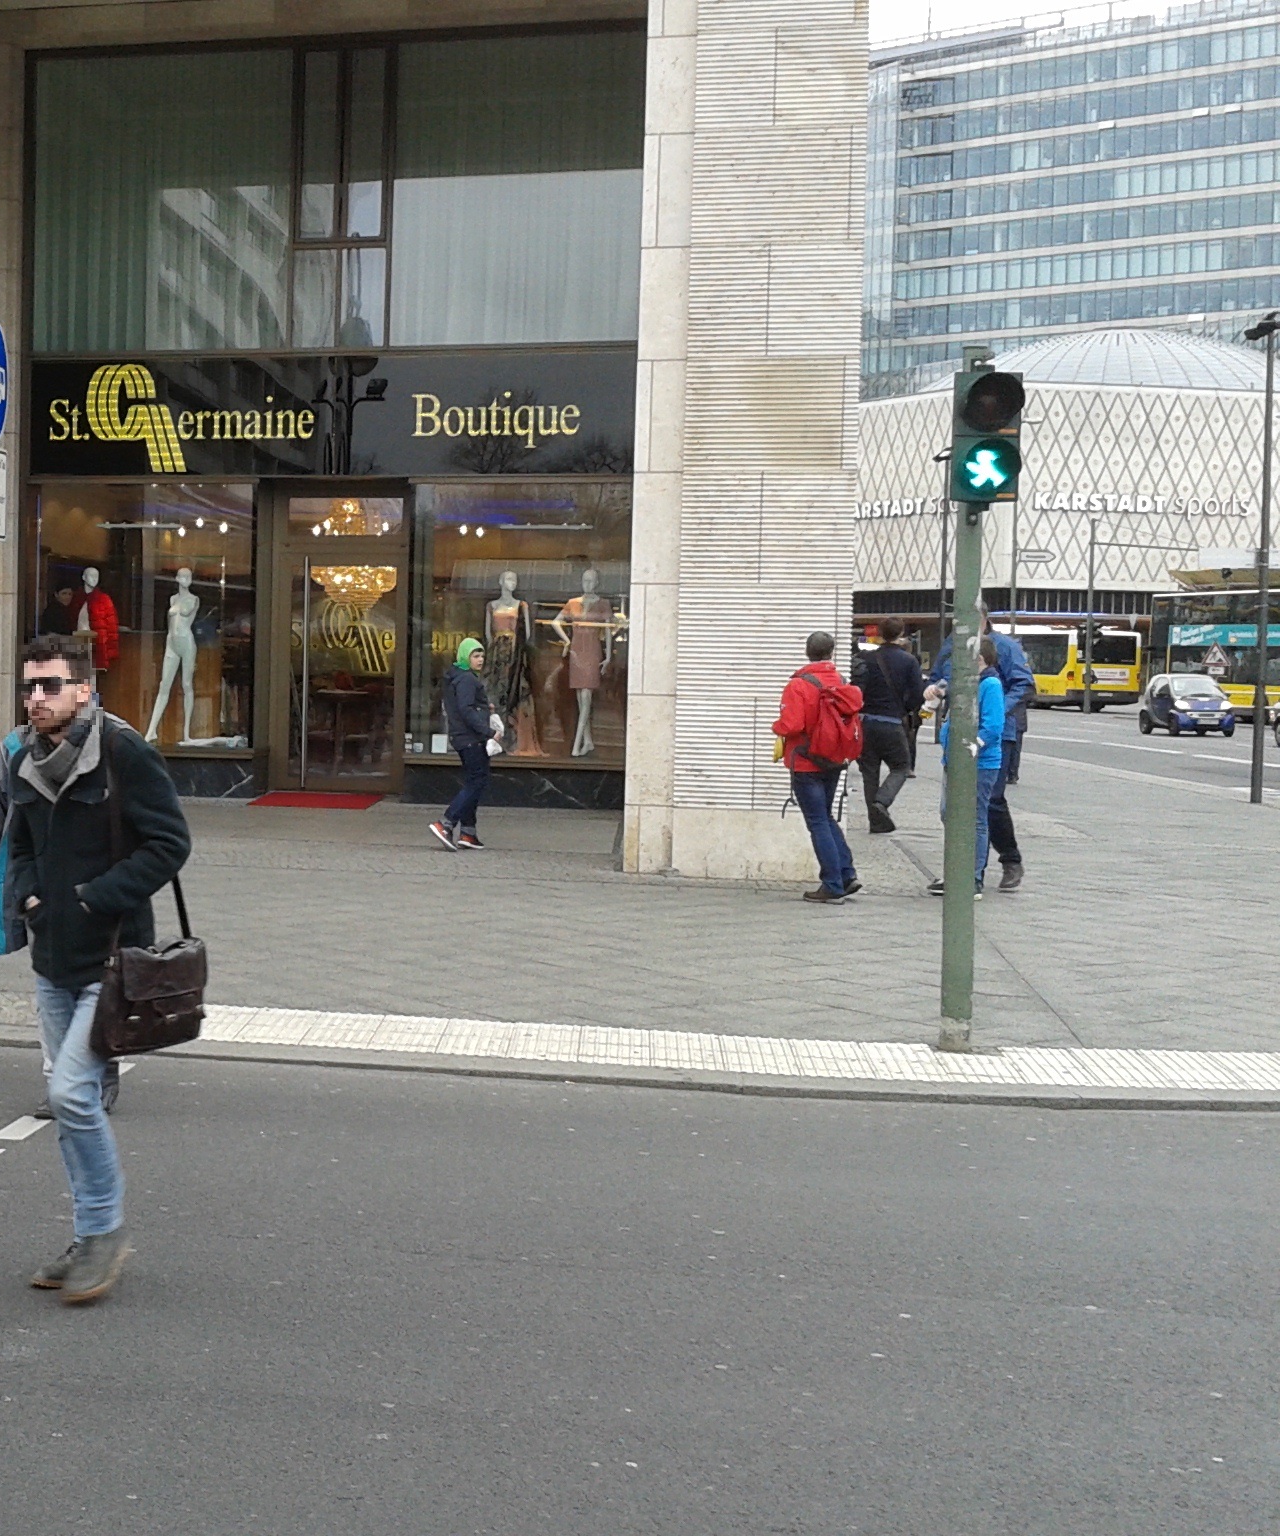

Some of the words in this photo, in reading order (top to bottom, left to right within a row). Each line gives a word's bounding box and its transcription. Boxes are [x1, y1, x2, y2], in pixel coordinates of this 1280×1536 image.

[49, 398, 90, 440] St.
[86, 364, 315, 472] Germaine
[411, 391, 581, 449] Boutique
[1033, 491, 1167, 513] KARSTADT
[1174, 493, 1252, 521] sports
